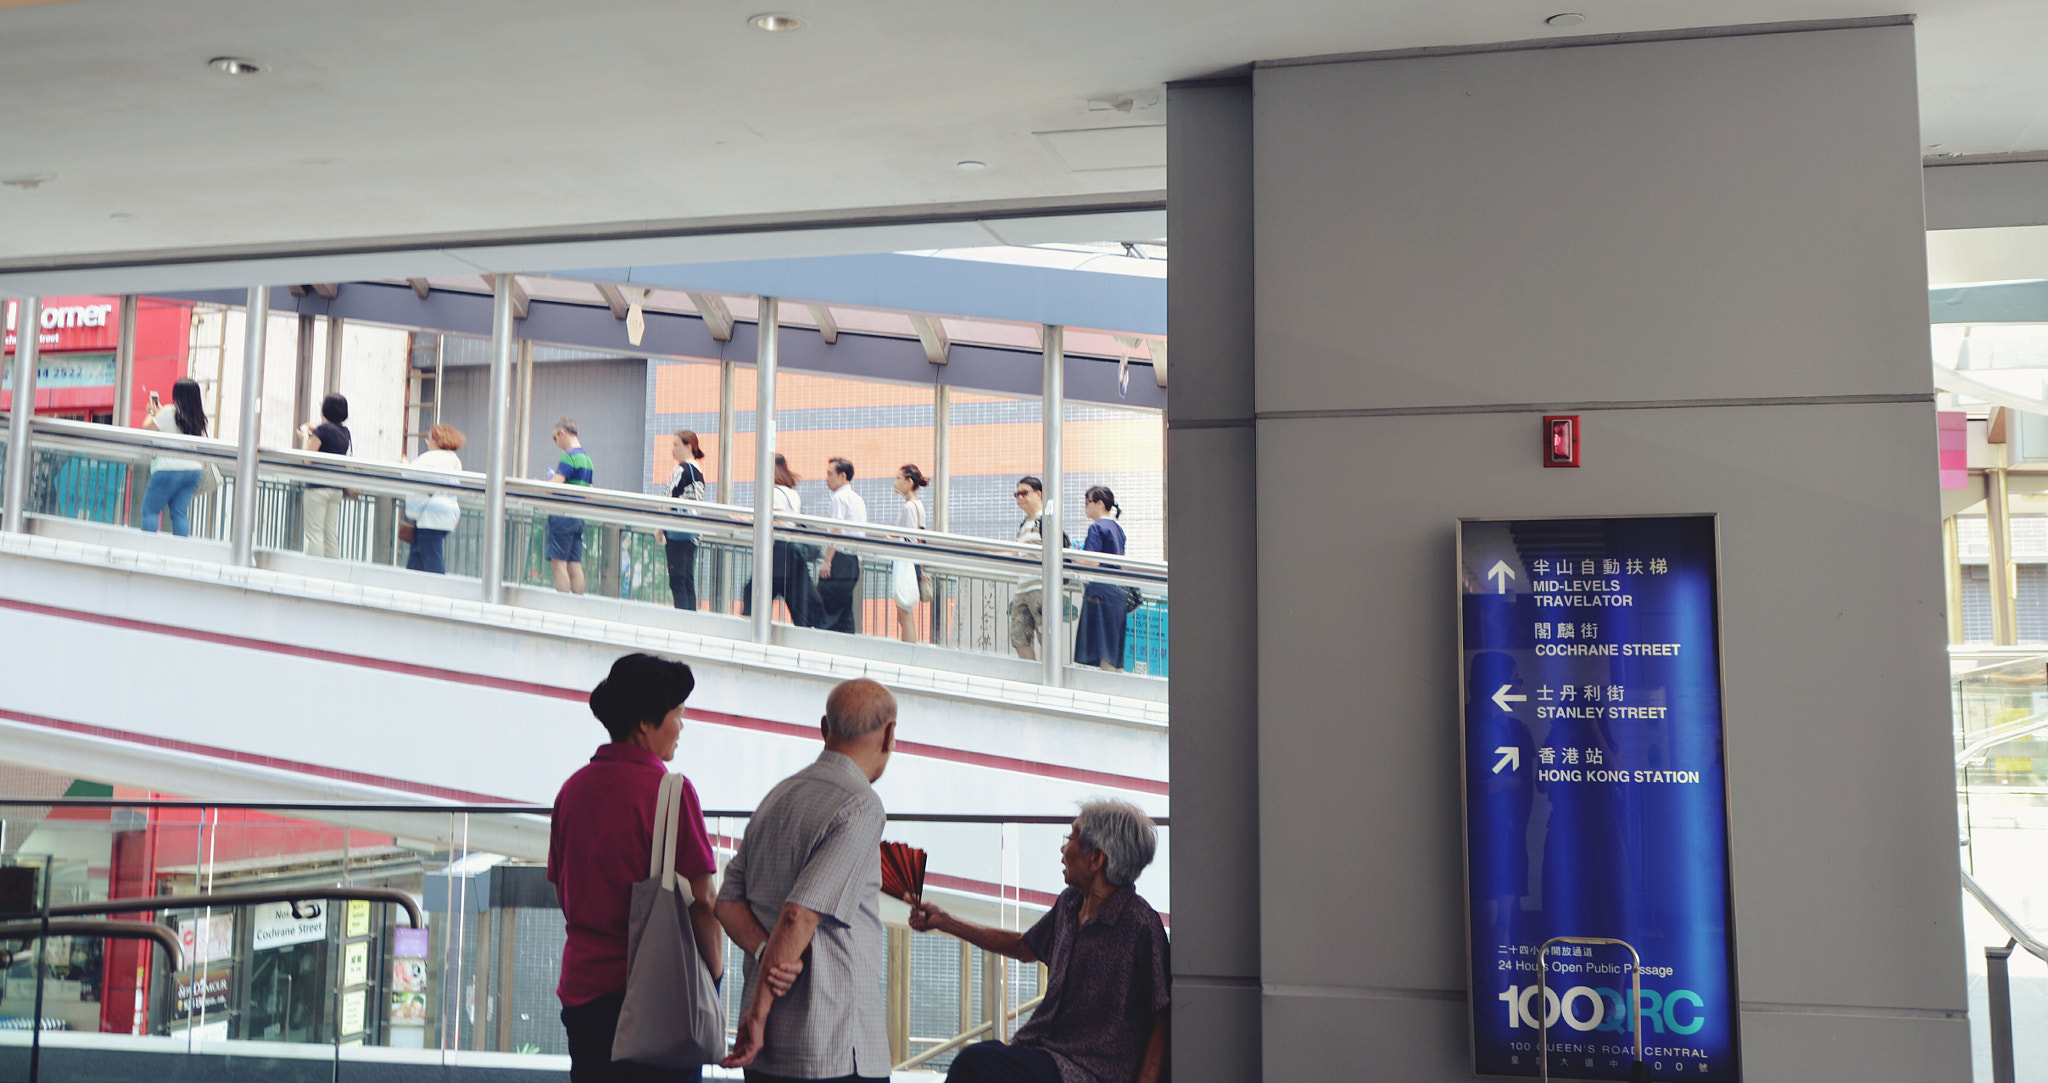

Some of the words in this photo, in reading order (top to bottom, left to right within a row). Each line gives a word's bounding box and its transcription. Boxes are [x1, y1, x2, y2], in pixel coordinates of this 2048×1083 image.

[1533, 558, 1668, 575] 半山自動扶梯
[1533, 580, 1621, 592] MID-LEVELS
[1534, 595, 1633, 607] TRAVELATOR
[1534, 622, 1599, 640] 閣麟街
[1535, 644, 1619, 656] COCHRANE
[1622, 644, 1681, 656] STREET
[1536, 685, 1625, 702] 士丹利街
[1537, 706, 1605, 719] STANLEY
[1609, 707, 1667, 719] STREET
[1538, 747, 1603, 765] 香港站
[1538, 769, 1582, 782] HONG
[1586, 770, 1630, 783] KONG
[1634, 771, 1700, 784] STATION
[256, 925, 296, 941] Cochrane
[298, 921, 322, 935] Street
[1498, 960, 1513, 971] 24
[1516, 960, 1549, 971] Hous
[1552, 961, 1583, 975] Open
[1586, 962, 1620, 974] Public
[1624, 963, 1674, 978] Pssage
[1510, 1042, 1531, 1051] 100
[1536, 1043, 1596, 1054] UEEN'S
[1644, 1047, 1708, 1059] CENTRAL
